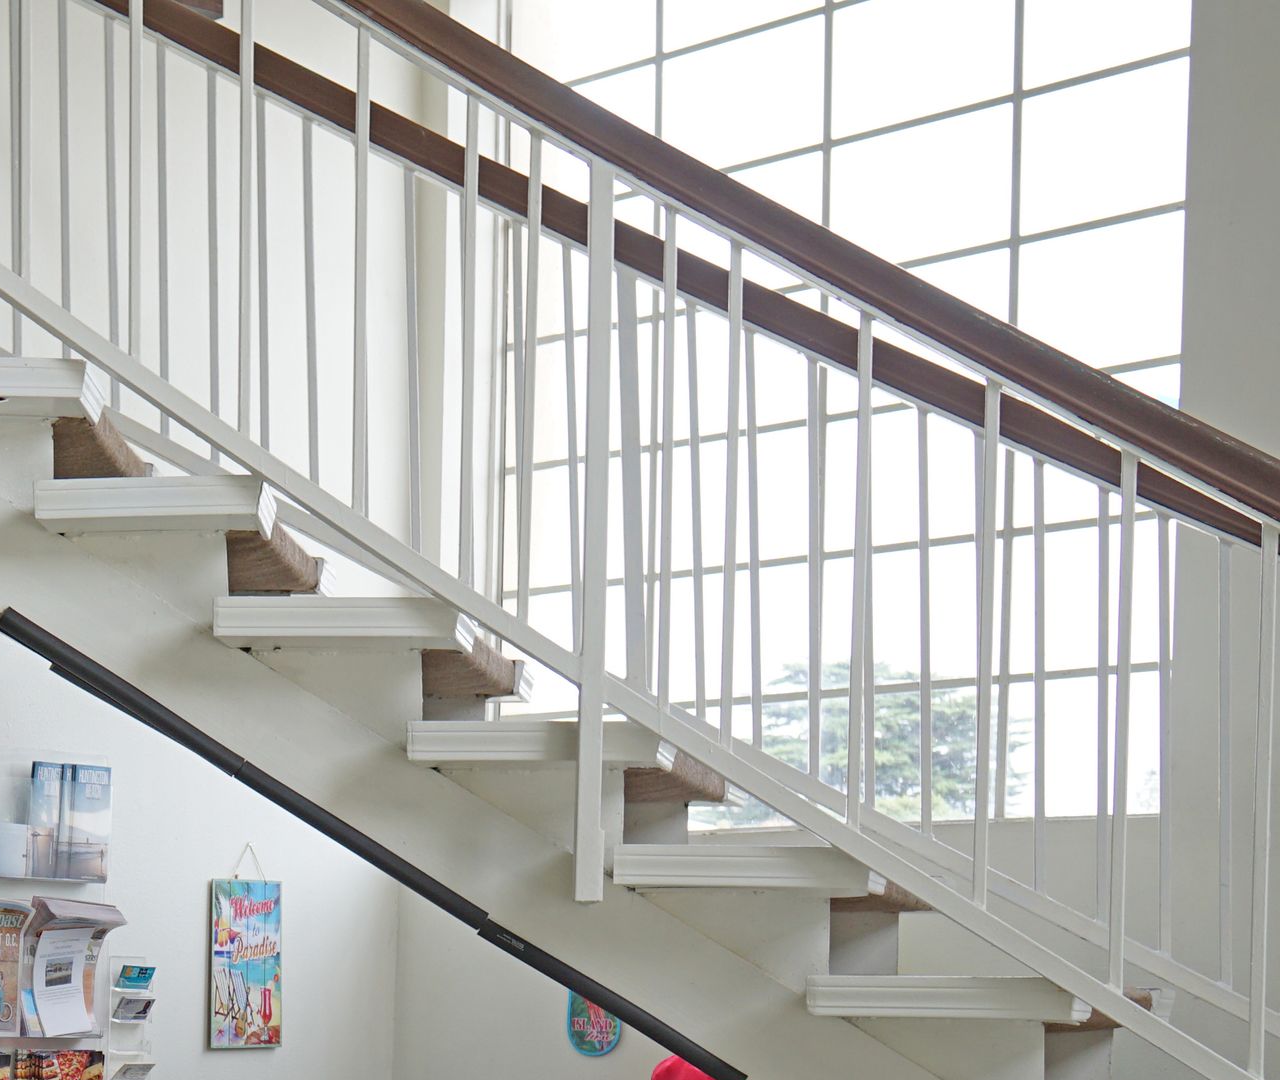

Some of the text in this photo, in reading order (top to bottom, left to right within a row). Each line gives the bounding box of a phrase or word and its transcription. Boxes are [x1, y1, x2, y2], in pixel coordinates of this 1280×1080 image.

[229, 894, 275, 921] Welcome
[252, 923, 260, 937] to
[232, 936, 277, 963] Paradise
[572, 1018, 614, 1031] ISLAND
